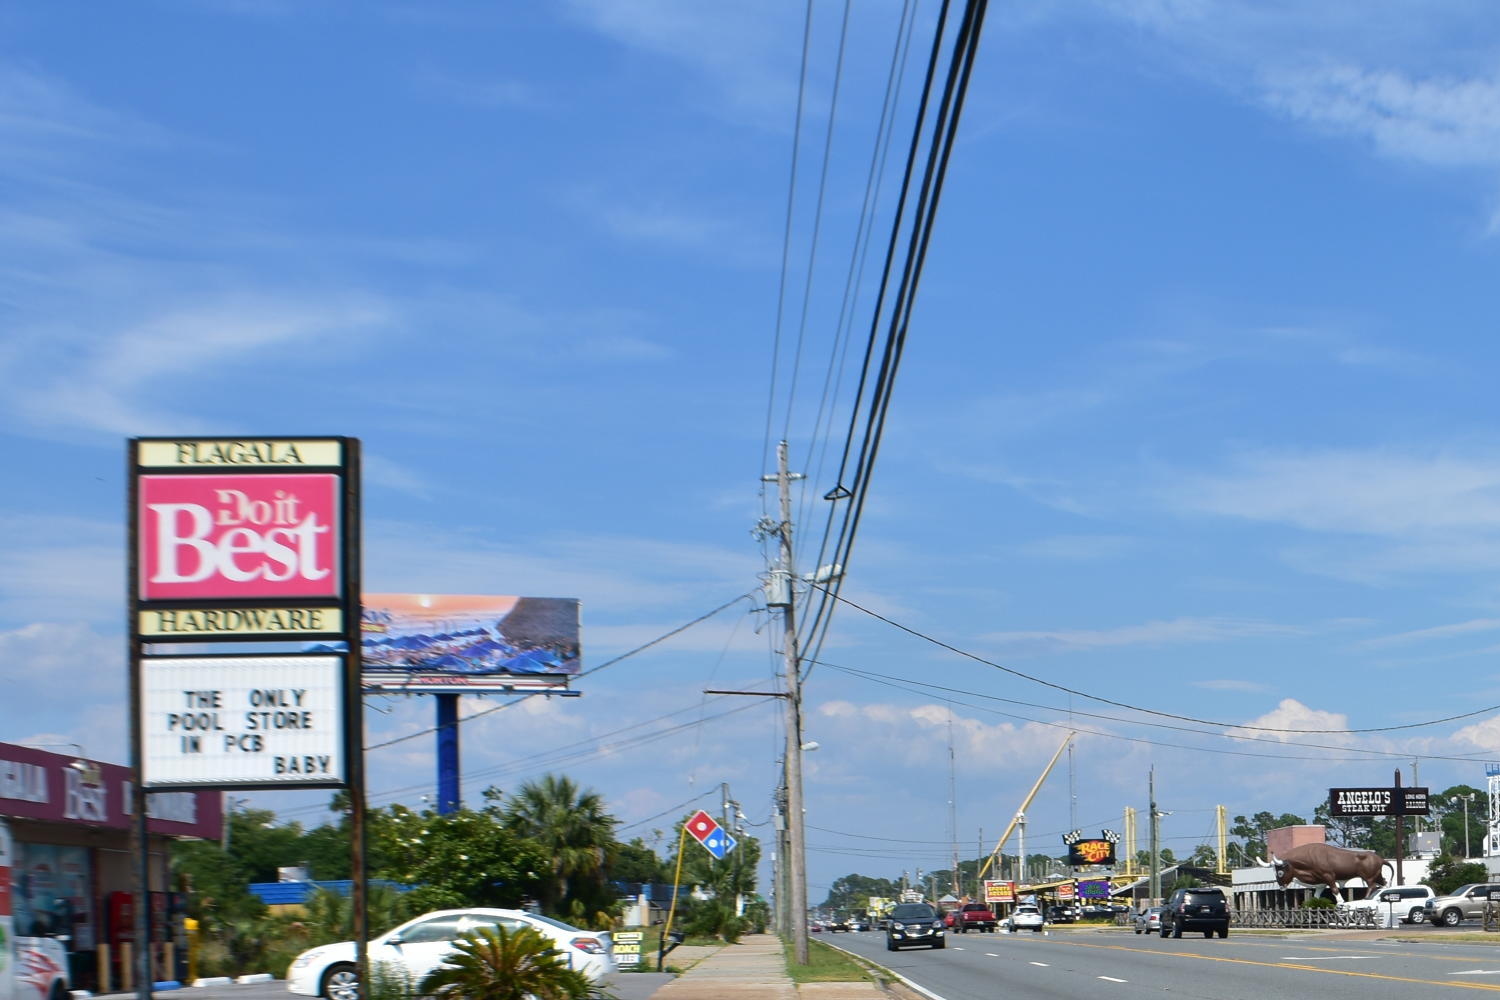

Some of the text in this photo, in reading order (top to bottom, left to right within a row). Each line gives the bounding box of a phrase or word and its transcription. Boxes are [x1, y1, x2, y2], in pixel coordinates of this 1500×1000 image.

[174, 441, 303, 464] FLAGALA
[213, 489, 301, 525] Do it
[147, 502, 330, 583] Best
[158, 609, 325, 633] HARDWARE
[184, 690, 306, 708] THE ONLY
[168, 711, 312, 731] POOL STORE
[181, 734, 264, 753] IN PCB
[274, 755, 332, 775] BABY
[1337, 791, 1391, 805] ANGELO'S
[1342, 804, 1386, 812] STEAK PIT
[1081, 842, 1111, 852] RACE
[1086, 850, 1110, 863] CITY
